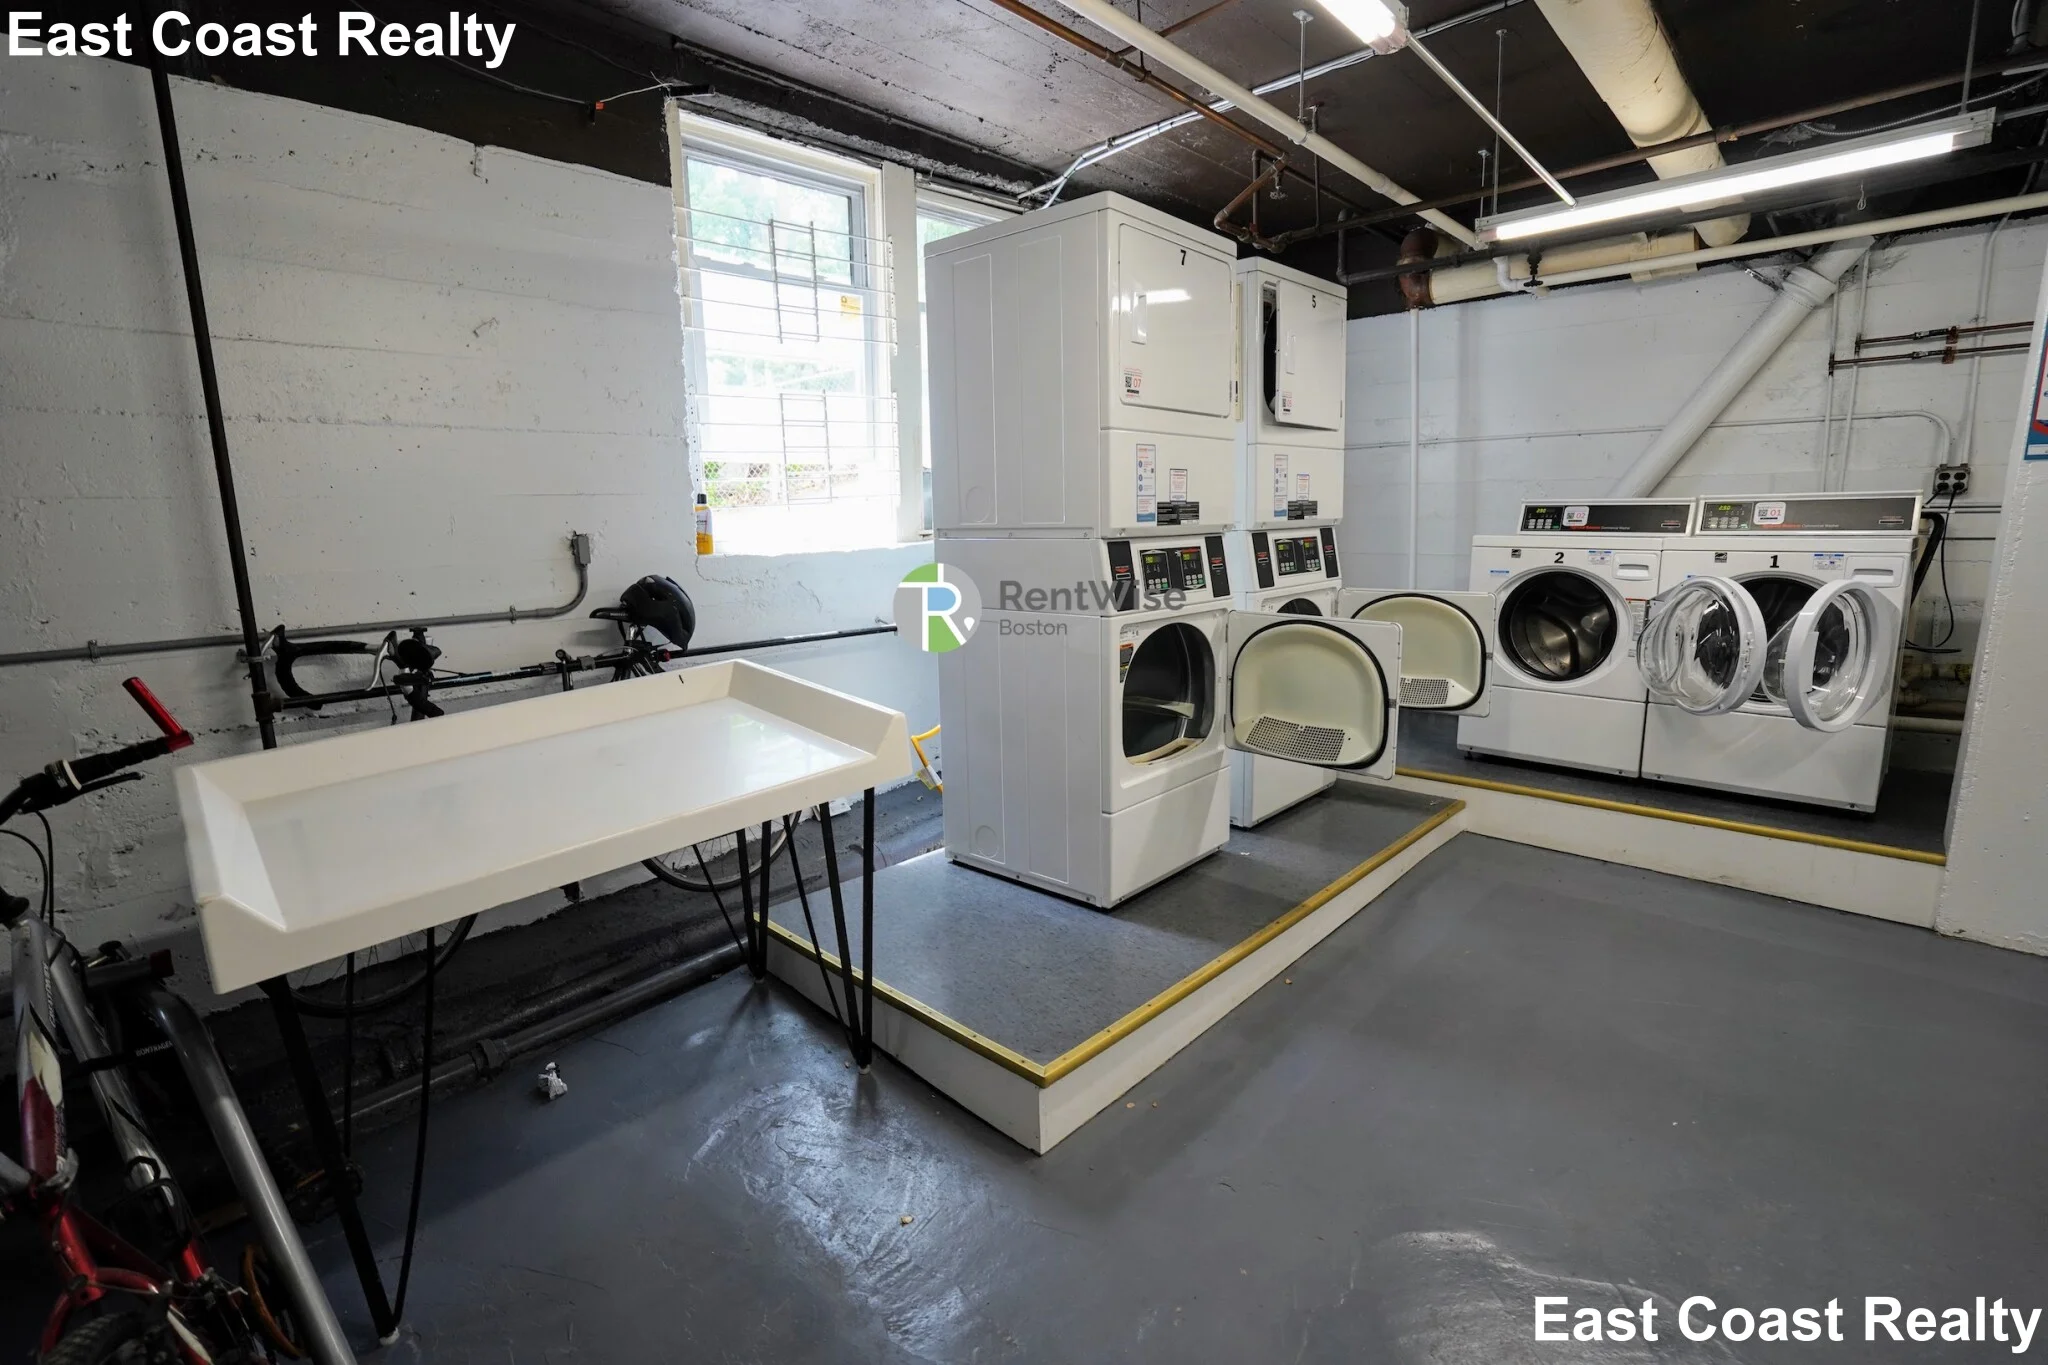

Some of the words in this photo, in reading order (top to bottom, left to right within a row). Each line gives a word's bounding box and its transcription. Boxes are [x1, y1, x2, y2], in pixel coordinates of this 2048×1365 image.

[1180, 249, 1187, 266] 7
[1311, 294, 1317, 309] 5
[1553, 551, 1565, 564] 2
[1769, 554, 1780, 569] 1
